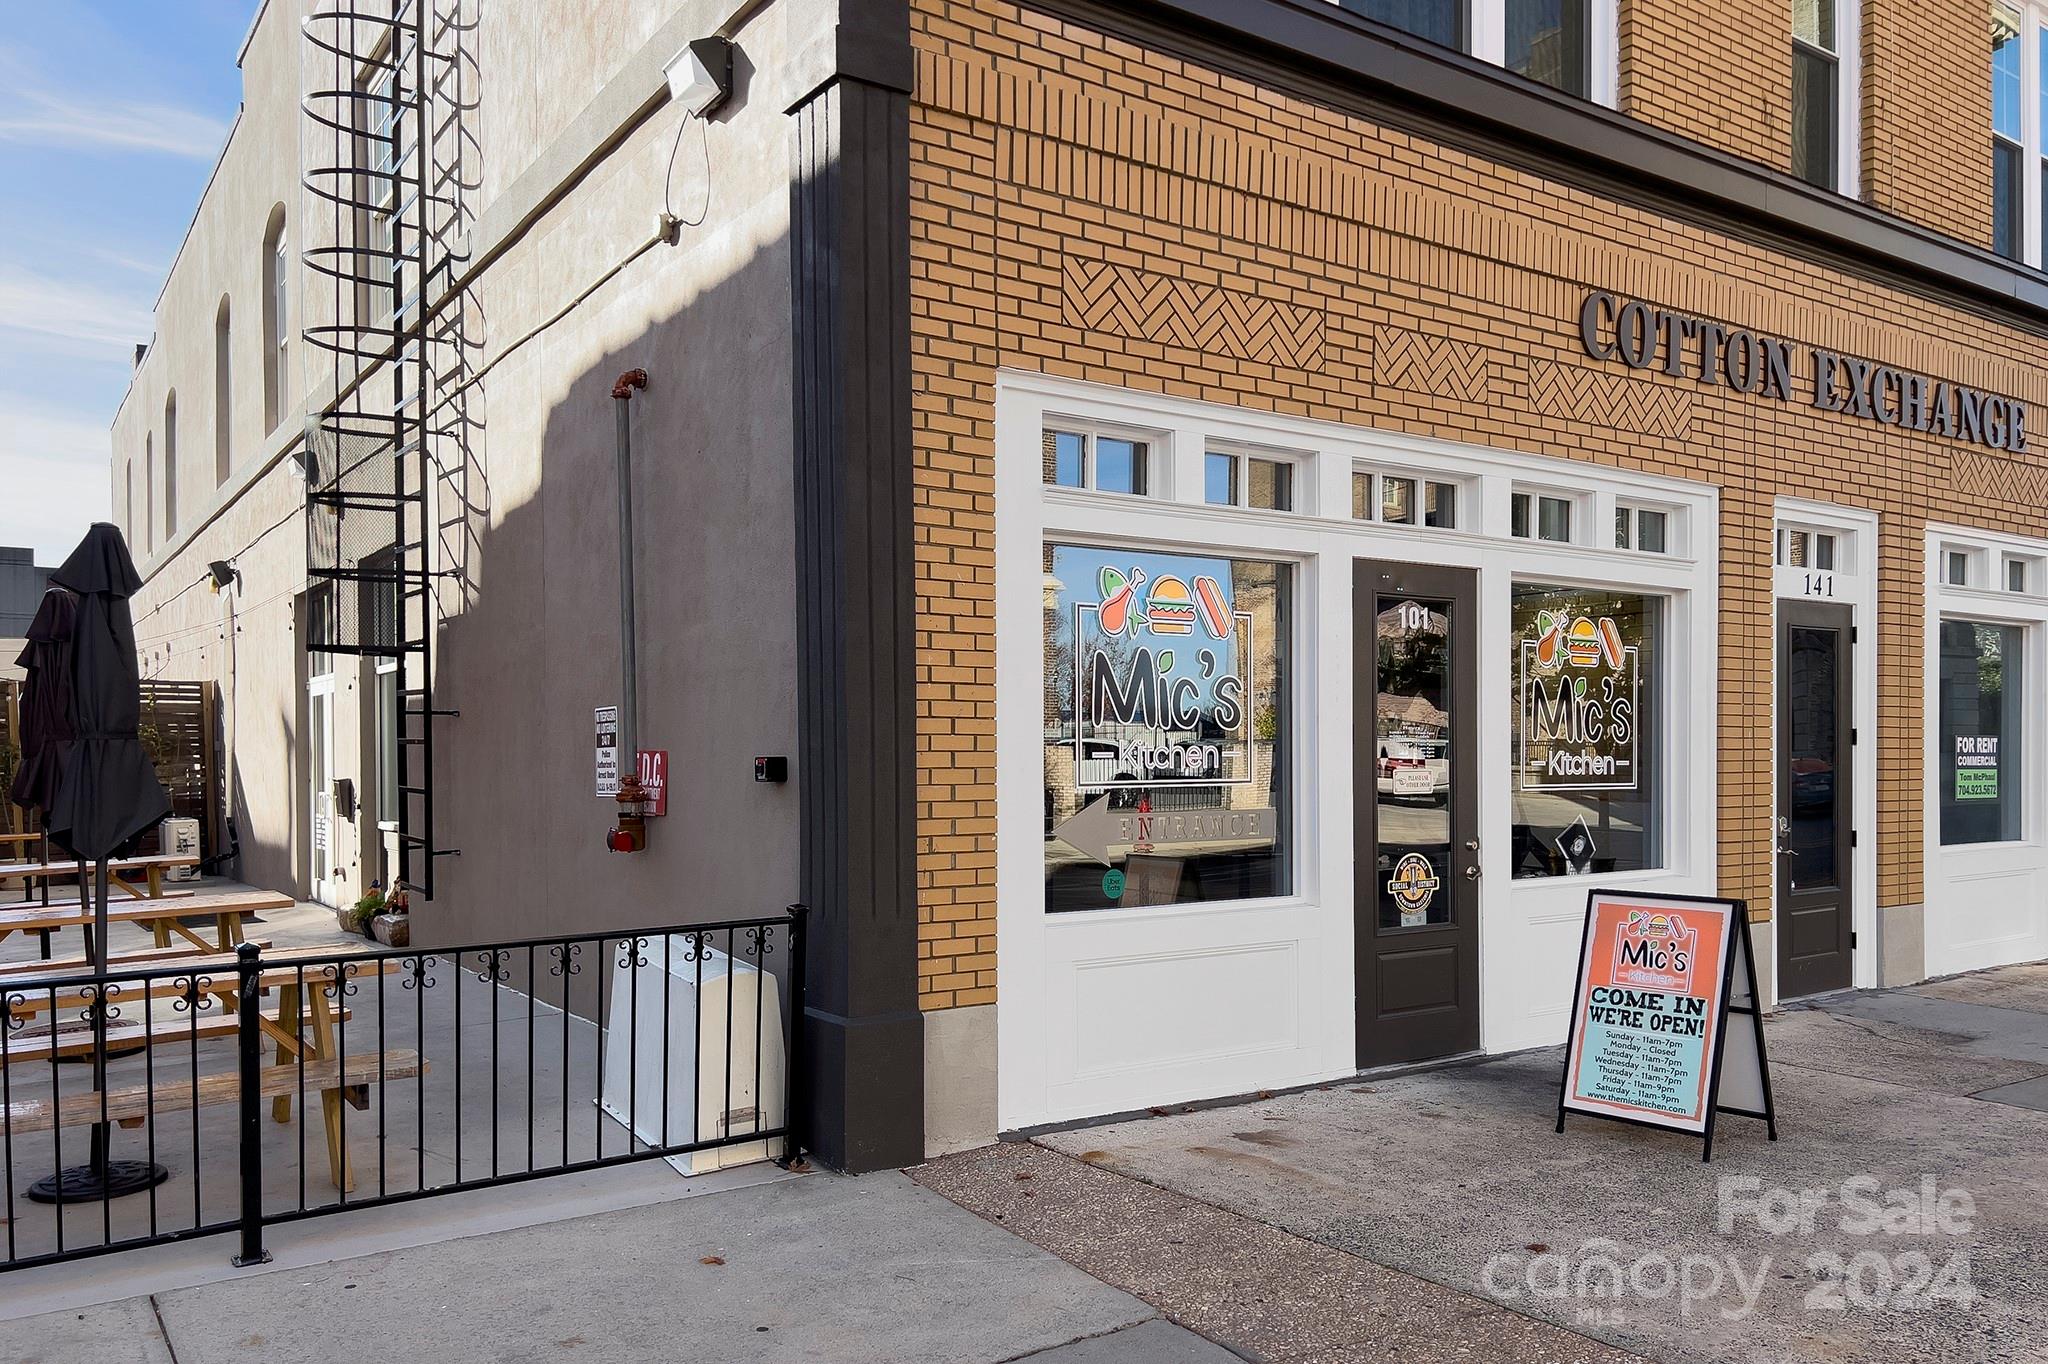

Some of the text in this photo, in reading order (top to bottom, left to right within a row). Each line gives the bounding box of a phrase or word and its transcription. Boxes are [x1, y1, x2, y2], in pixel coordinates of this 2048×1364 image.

[1579, 291, 2028, 454] COTTON EXCHANGE
[1804, 573, 1833, 597] 141
[1399, 606, 1428, 630] 101
[1091, 646, 1243, 731] Mic's
[1531, 675, 1632, 744] Mic's
[1119, 738, 1219, 769] Kitchen
[1957, 737, 1998, 753] FOR RENT
[1548, 750, 1615, 776] Kitchen
[1957, 755, 1997, 766] COMMERCIAL
[1960, 773, 1972, 781] Tom
[1119, 813, 1261, 843] ENTRANCE
[1620, 939, 1689, 972] Mic's
[1628, 970, 1674, 985] Kitchen
[1591, 986, 1706, 1016] COME IN
[1589, 1005, 1705, 1038] WE'RE OPEN!
[1605, 1030, 1635, 1043] Sunday
[1642, 1036, 1683, 1050] 11am-7pm
[1609, 1040, 1641, 1053] Monday
[1649, 1046, 1677, 1057] Closed
[1594, 1055, 1640, 1070] Wednesday
[1647, 1064, 1689, 1078] 11am-7pm
[1602, 1048, 1634, 1060] Tuesday
[1641, 1054, 1682, 1068] 11am-7pm
[1598, 1065, 1634, 1079] Thursday
[1641, 1072, 1682, 1087] 11am-7pm
[1602, 1075, 1626, 1088] Friday
[1633, 1080, 1675, 1094] 11am-9pm
[1587, 1091, 1687, 1114] www.themicskitchen.com
[1595, 1082, 1631, 1097] Saturday
[1638, 1090, 1680, 1104] 11am-9pm
